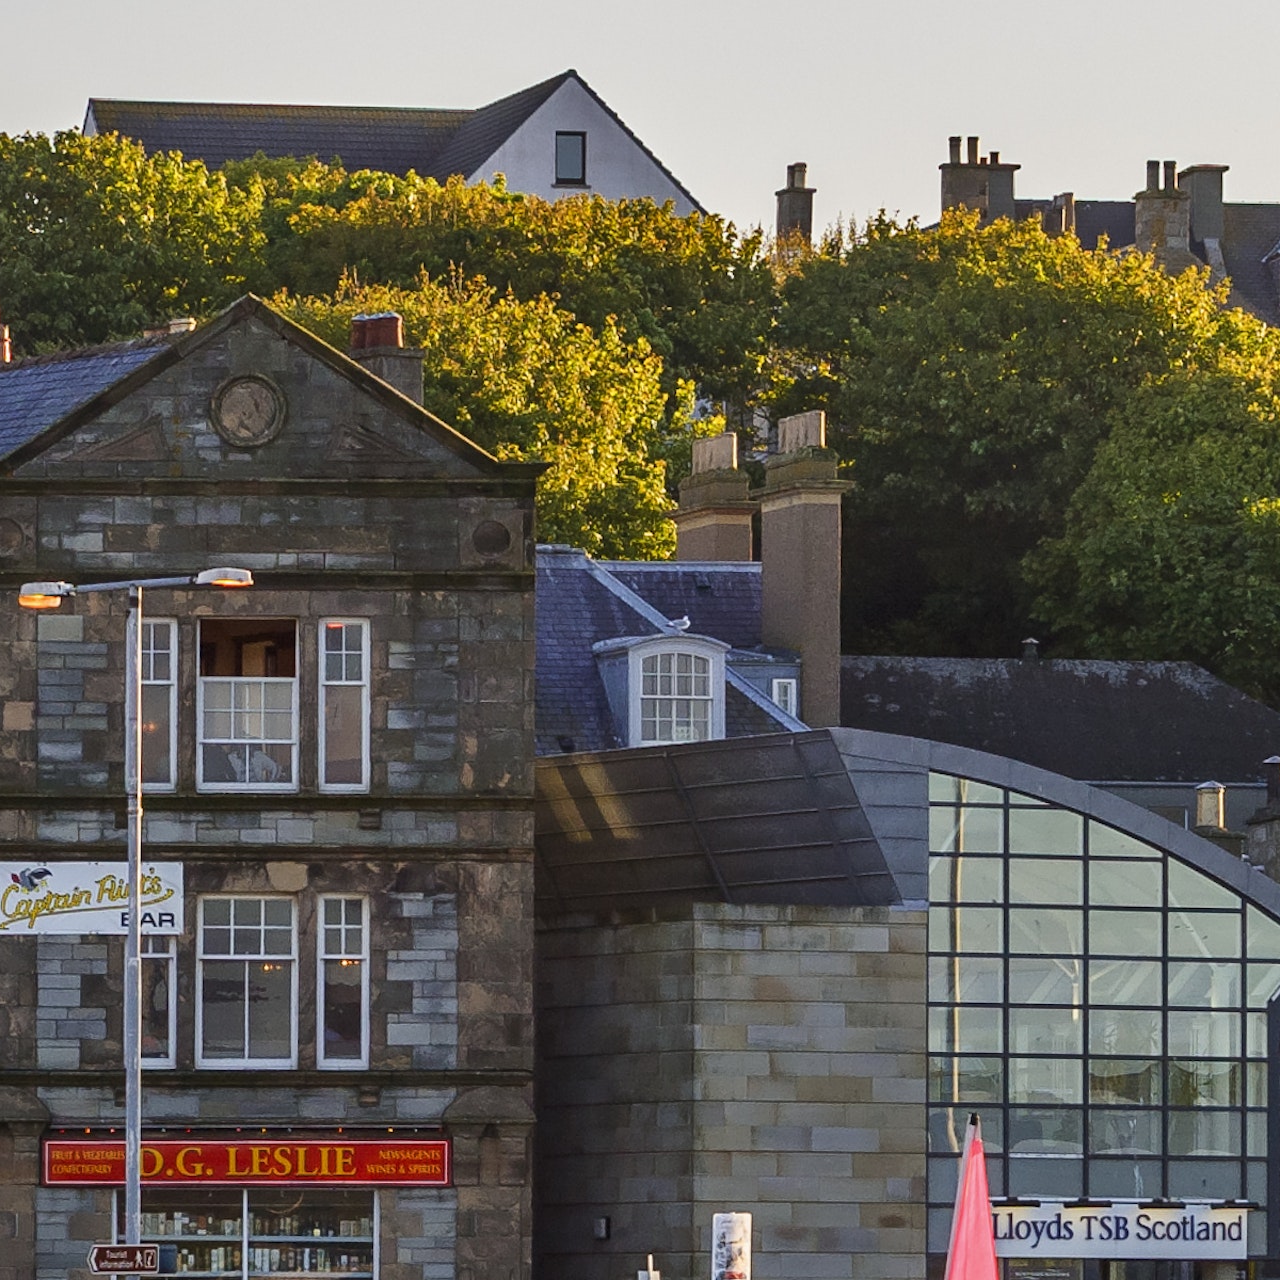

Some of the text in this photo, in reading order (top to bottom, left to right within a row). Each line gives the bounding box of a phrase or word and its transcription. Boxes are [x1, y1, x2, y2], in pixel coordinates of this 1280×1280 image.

[0, 883, 91, 929] Captain
[51, 1150, 73, 1160] FRUIT
[82, 1150, 125, 1160] VEGETABLES
[139, 1147, 357, 1177] D.G. LESLIE
[378, 1150, 441, 1160] NEWSAGENTS
[367, 1164, 396, 1174] WINES
[408, 1164, 441, 1174] SPIRITS
[992, 1213, 1243, 1248] Lloyds TSB Scotland
